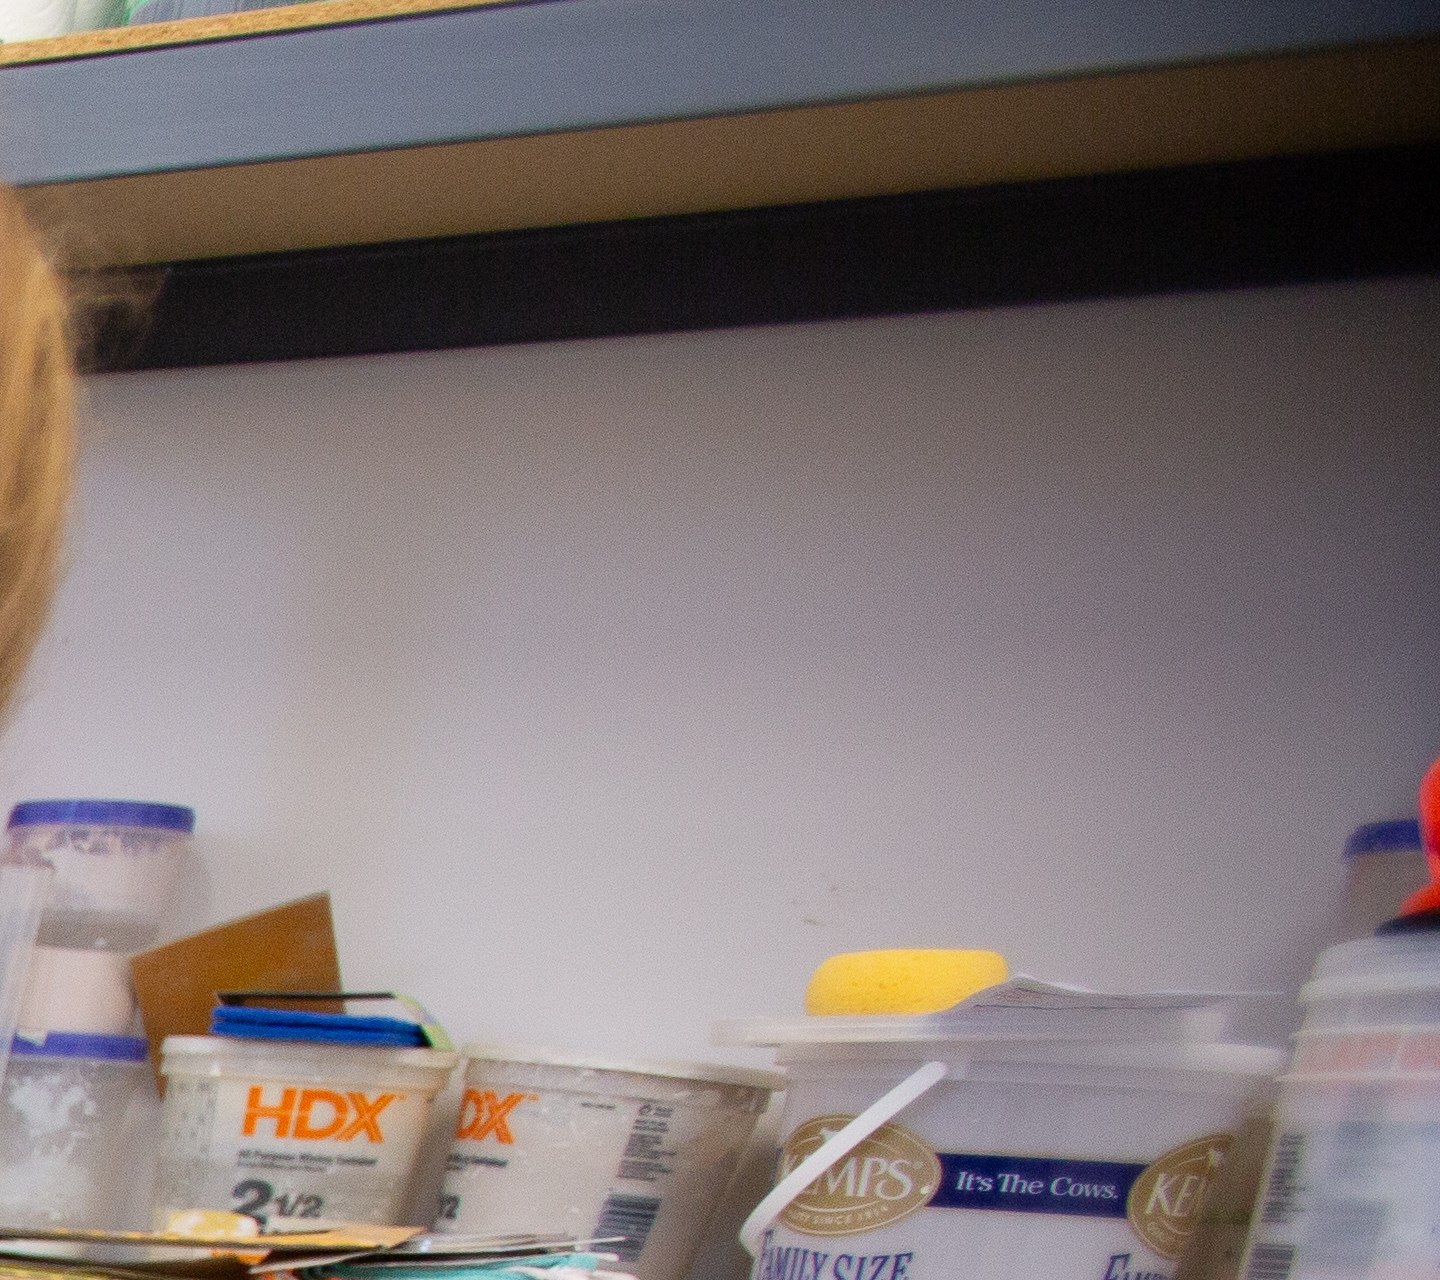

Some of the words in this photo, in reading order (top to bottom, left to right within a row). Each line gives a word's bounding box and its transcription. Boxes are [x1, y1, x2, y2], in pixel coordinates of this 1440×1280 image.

[240, 1085, 397, 1144] HDX
[454, 1088, 527, 1145] DX
[955, 1171, 994, 1192] It's
[996, 1173, 1045, 1195] The
[1049, 1177, 1119, 1200] Cows.
